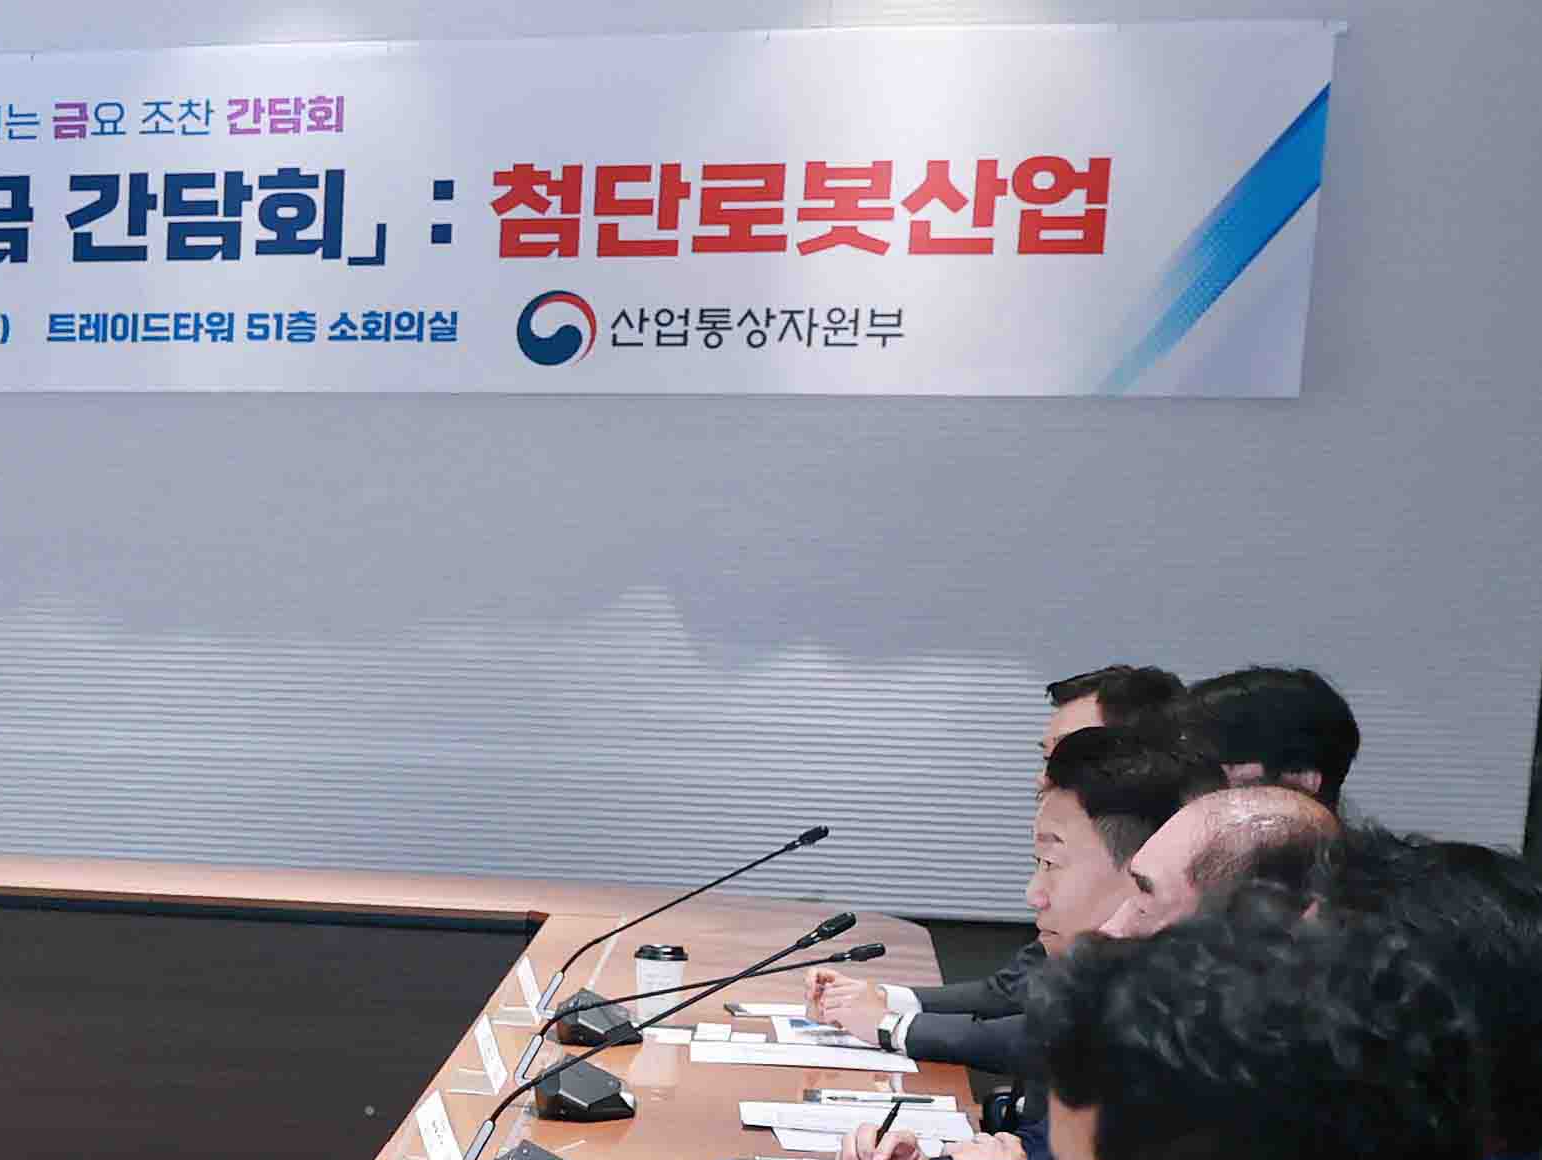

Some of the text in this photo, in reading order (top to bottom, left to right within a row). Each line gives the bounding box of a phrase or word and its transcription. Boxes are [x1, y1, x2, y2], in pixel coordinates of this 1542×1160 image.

[51, 101, 128, 141] 금요
[138, 98, 215, 138] 조찬
[226, 95, 345, 136] 간담회
[489, 155, 1113, 259] 첨단로봇산업
[45, 310, 236, 344] 트레이드타워
[245, 309, 318, 344] 51층
[326, 309, 460, 344] 소회의실
[610, 303, 905, 350] 산업통상자원부
